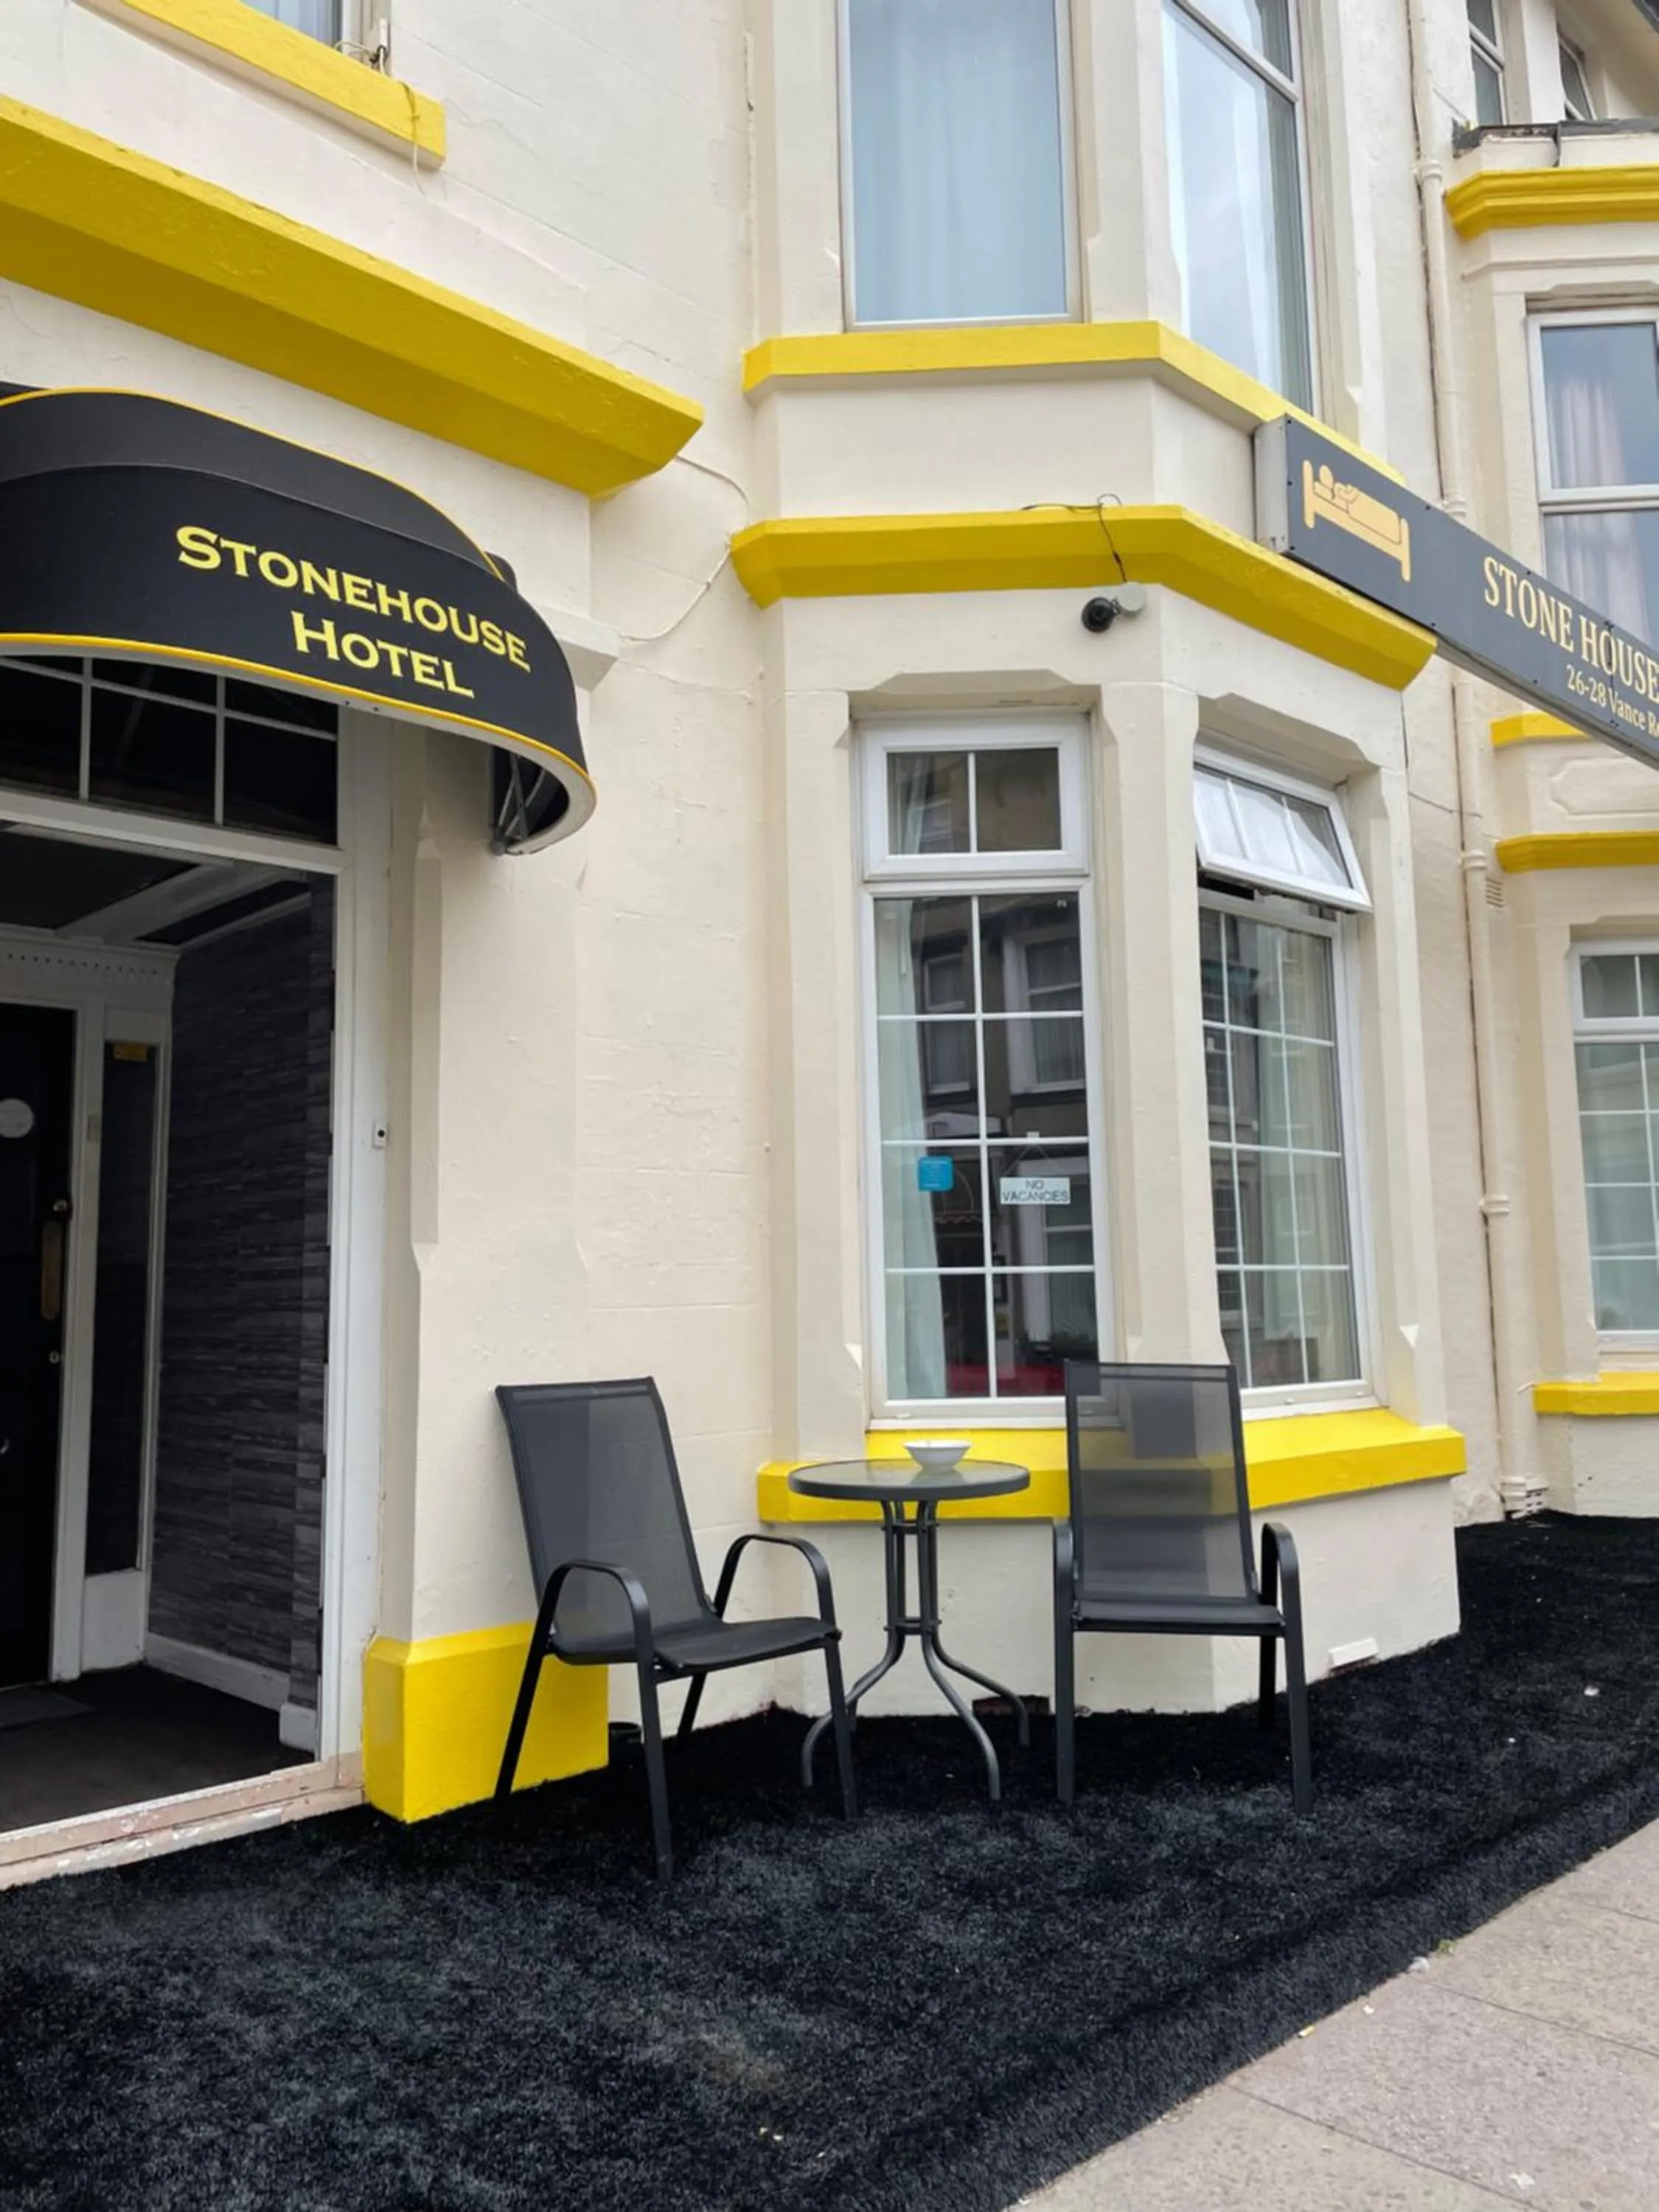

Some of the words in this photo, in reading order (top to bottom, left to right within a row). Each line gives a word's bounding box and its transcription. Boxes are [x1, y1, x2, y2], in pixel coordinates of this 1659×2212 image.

[176, 526, 531, 672] STONEHOUSE
[1484, 556, 1573, 653] STONE
[1579, 614, 1659, 704] HOUSE
[291, 611, 475, 698] HOTEL
[1566, 664, 1607, 707] 26-28
[1608, 687, 1646, 731] Vance
[1003, 1190, 1069, 1202] VACANCIES
[1026, 1180, 1045, 1190] NO
